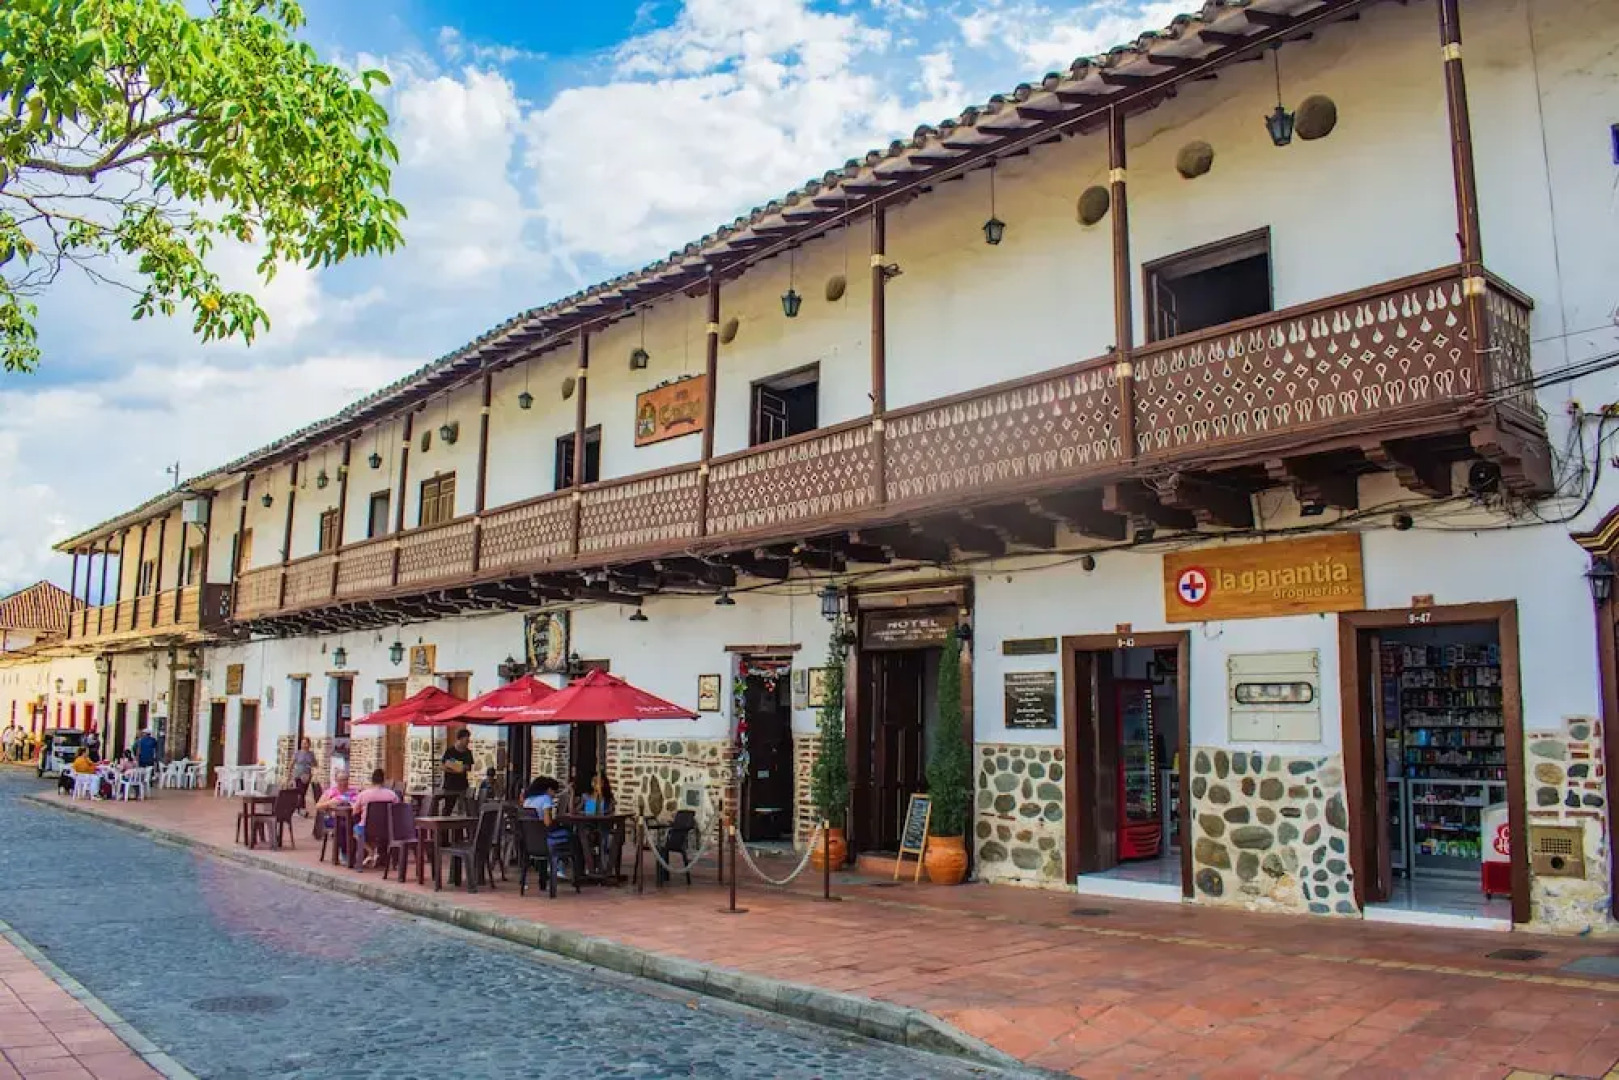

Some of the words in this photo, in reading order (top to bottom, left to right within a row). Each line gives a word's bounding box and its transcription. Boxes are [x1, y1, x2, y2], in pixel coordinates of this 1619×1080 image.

[1215, 568, 1237, 590] la
[1241, 556, 1348, 592] garantía
[887, 619, 940, 629] HOTEL
